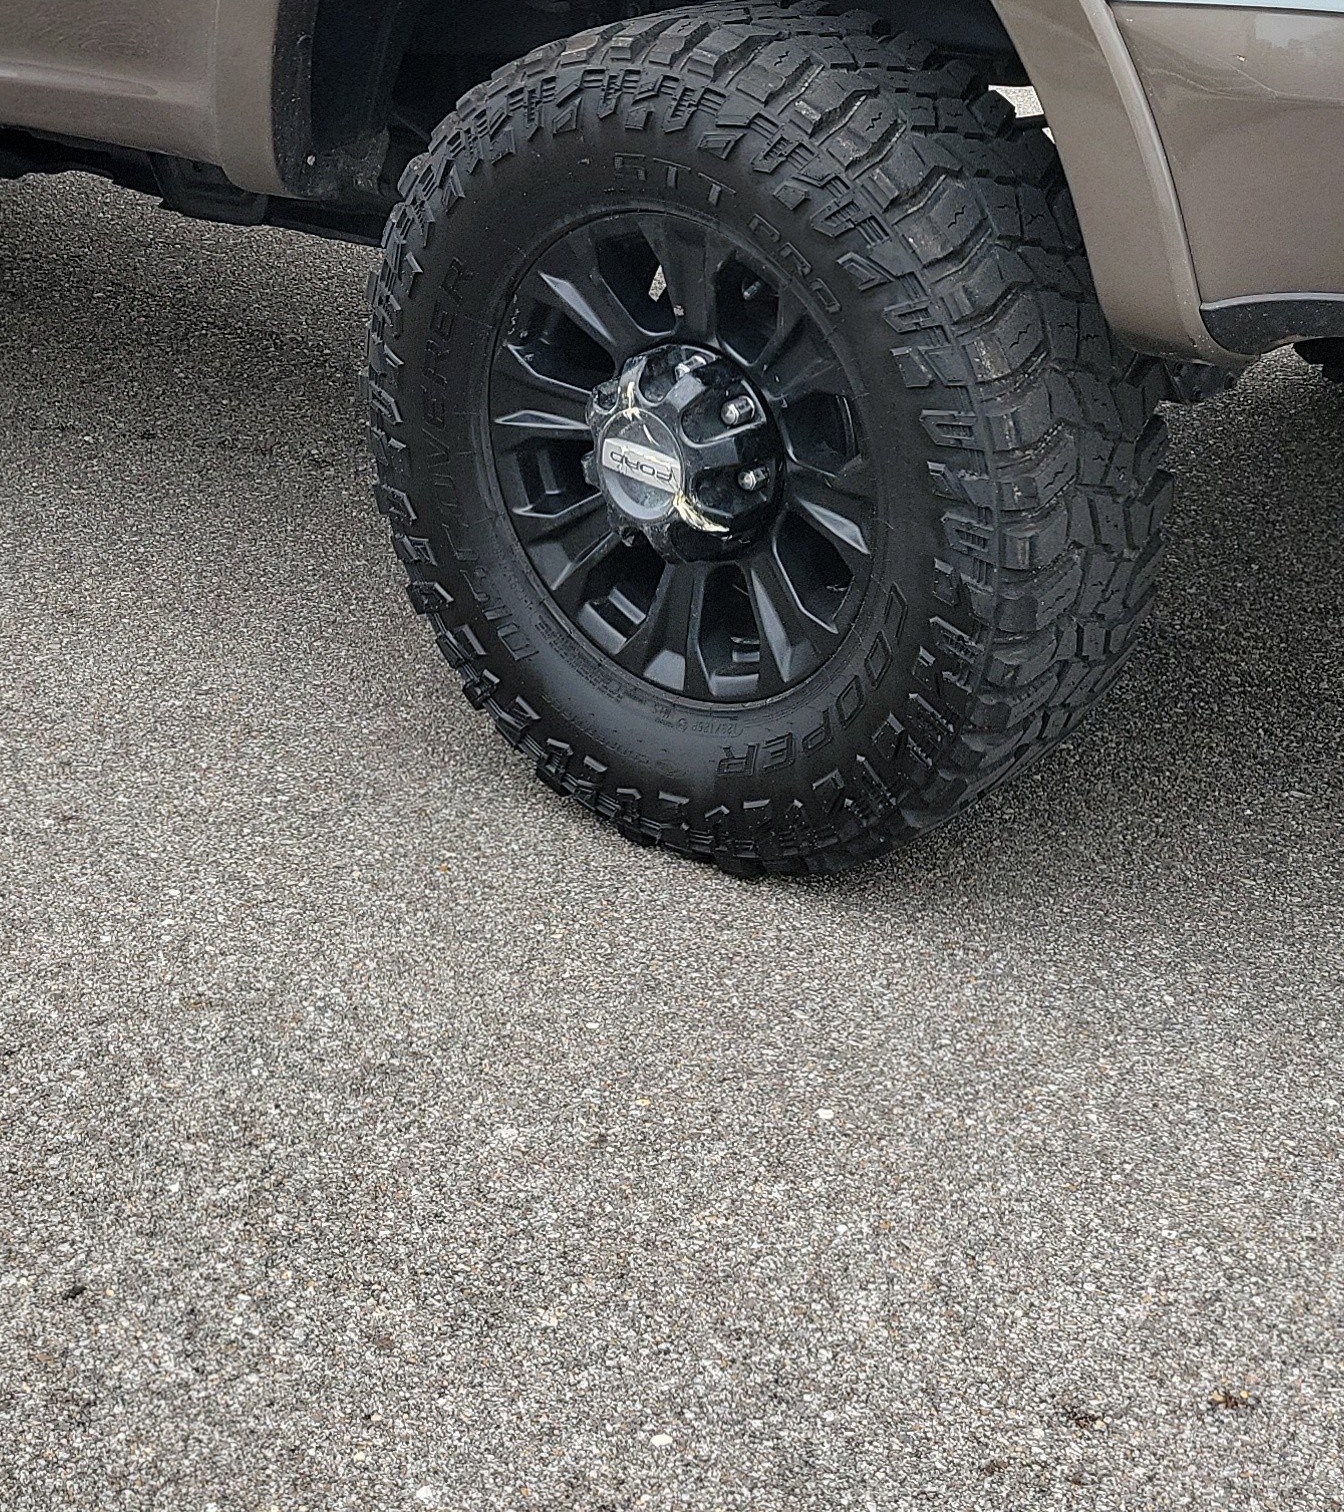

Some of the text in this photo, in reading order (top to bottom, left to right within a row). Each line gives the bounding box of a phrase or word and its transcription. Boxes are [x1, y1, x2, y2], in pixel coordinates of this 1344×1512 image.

[614, 152, 841, 313] STT PRO
[610, 451, 672, 482] FORD
[716, 582, 909, 775] COOPER
